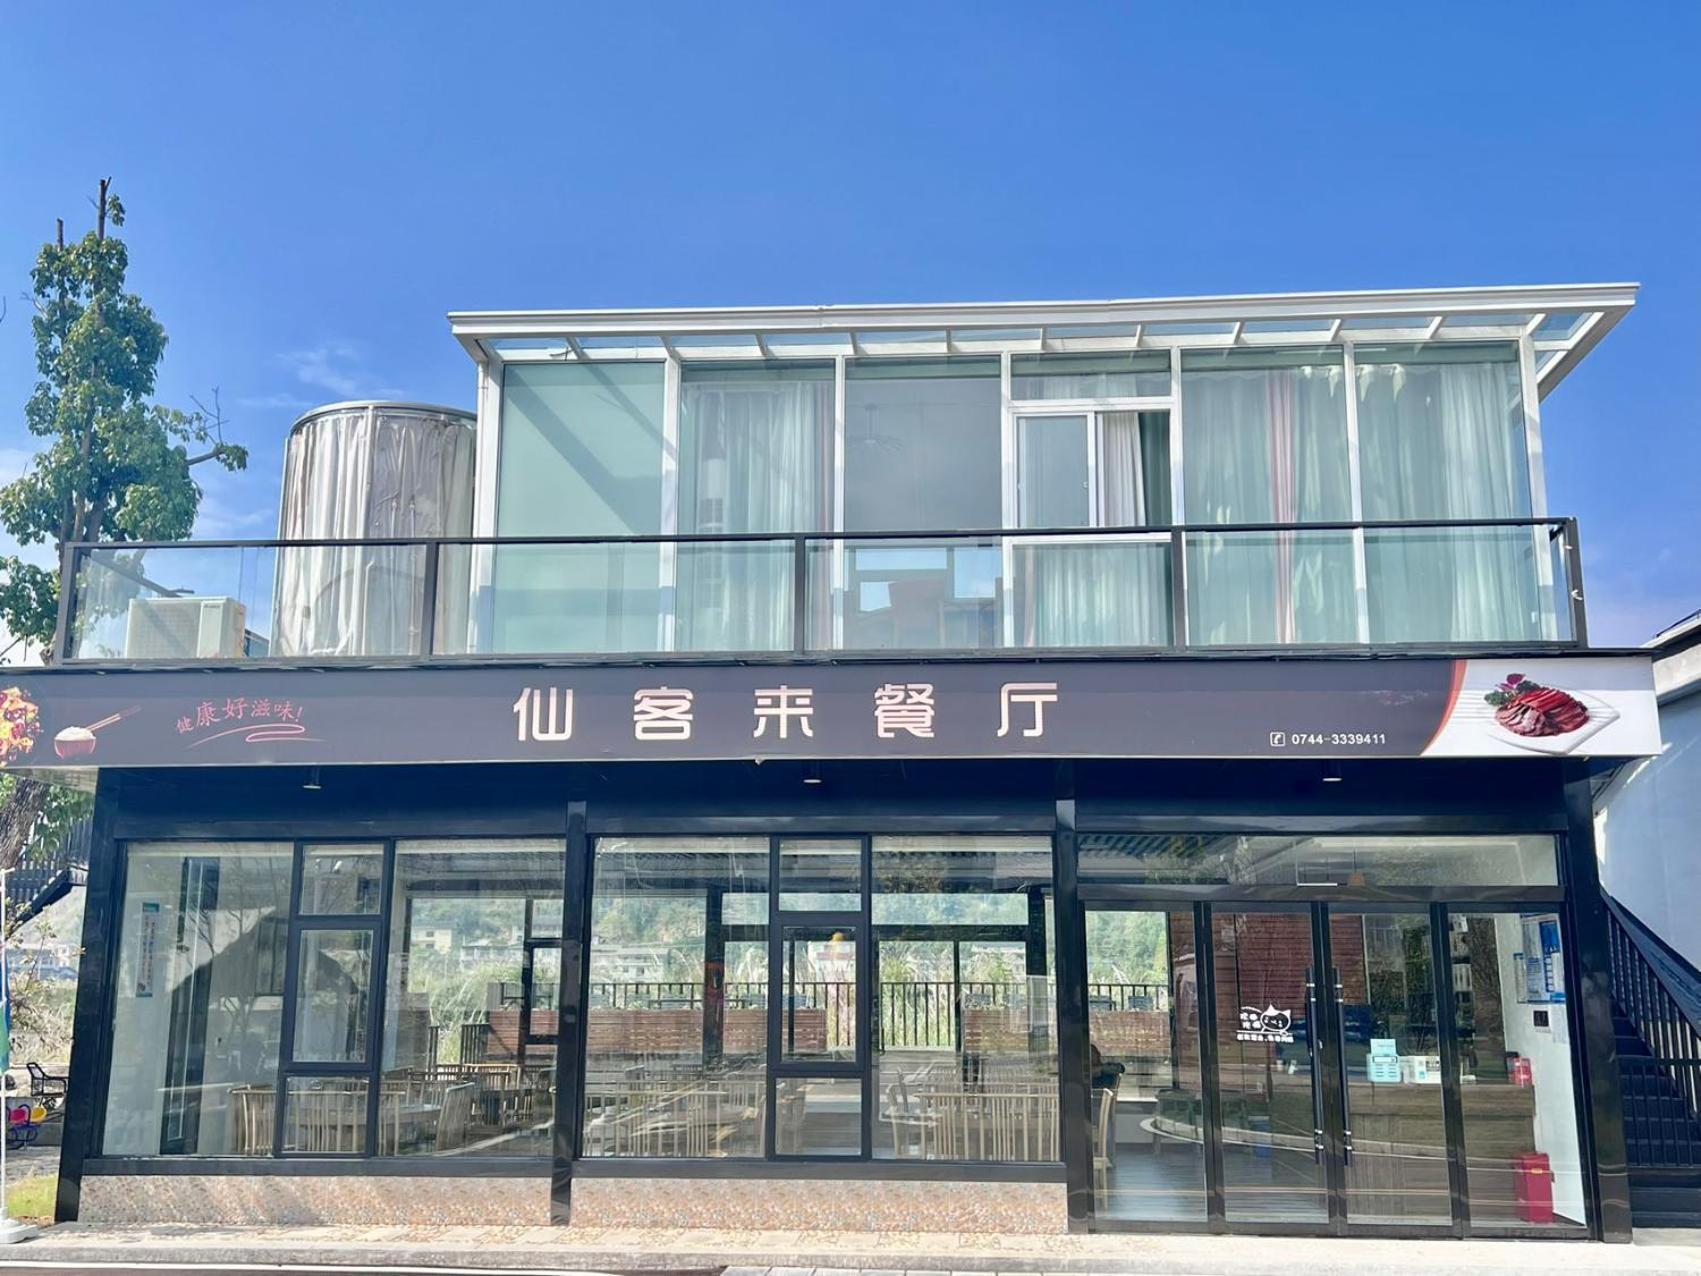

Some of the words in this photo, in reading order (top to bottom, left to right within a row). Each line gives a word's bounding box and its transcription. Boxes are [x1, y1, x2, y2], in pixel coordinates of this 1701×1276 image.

[513, 682, 1058, 741] 仙客来餐厅
[1291, 733, 1386, 745] 0744-3339411
